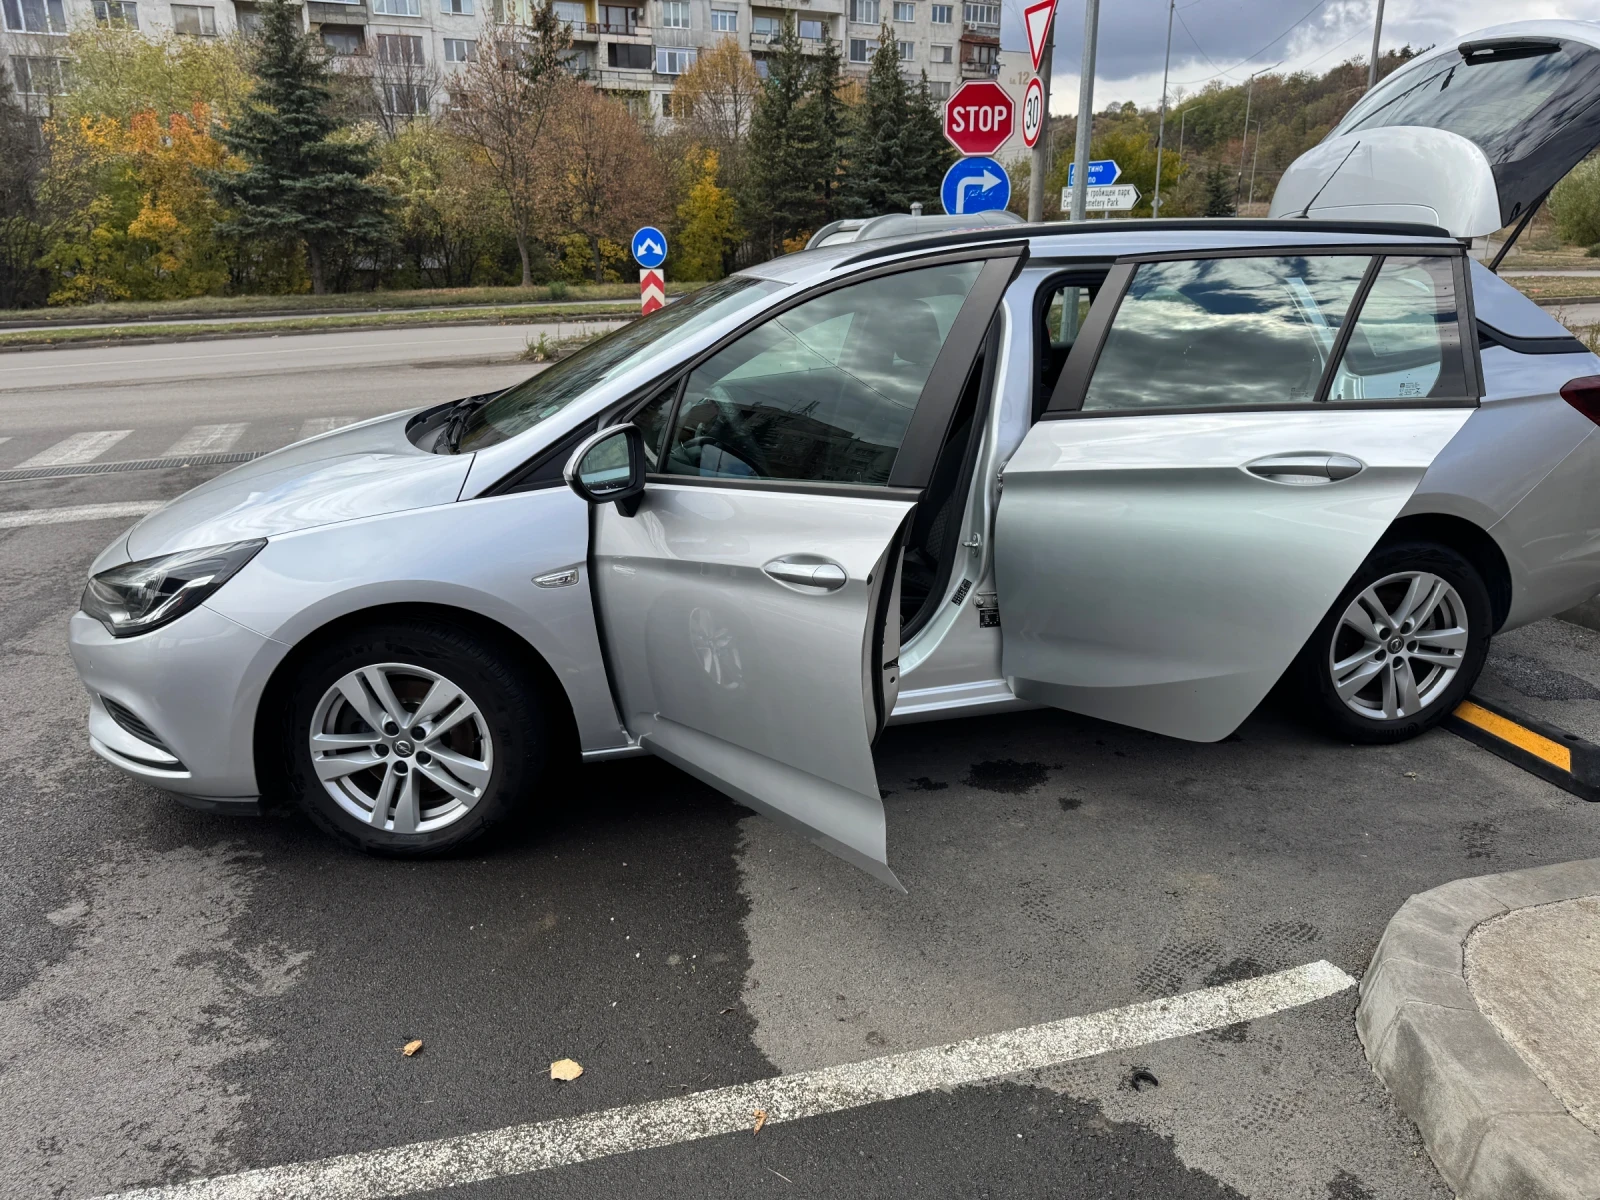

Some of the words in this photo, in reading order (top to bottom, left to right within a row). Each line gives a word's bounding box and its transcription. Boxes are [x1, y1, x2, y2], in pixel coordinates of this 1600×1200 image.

[1017, 71, 1030, 85] 12
[952, 105, 1007, 132] STOP
[1026, 95, 1039, 130] 30
[1090, 188, 1116, 198] гробищен
[1117, 188, 1131, 198] парк
[1086, 199, 1105, 209] emetery
[1106, 197, 1119, 207] Park
